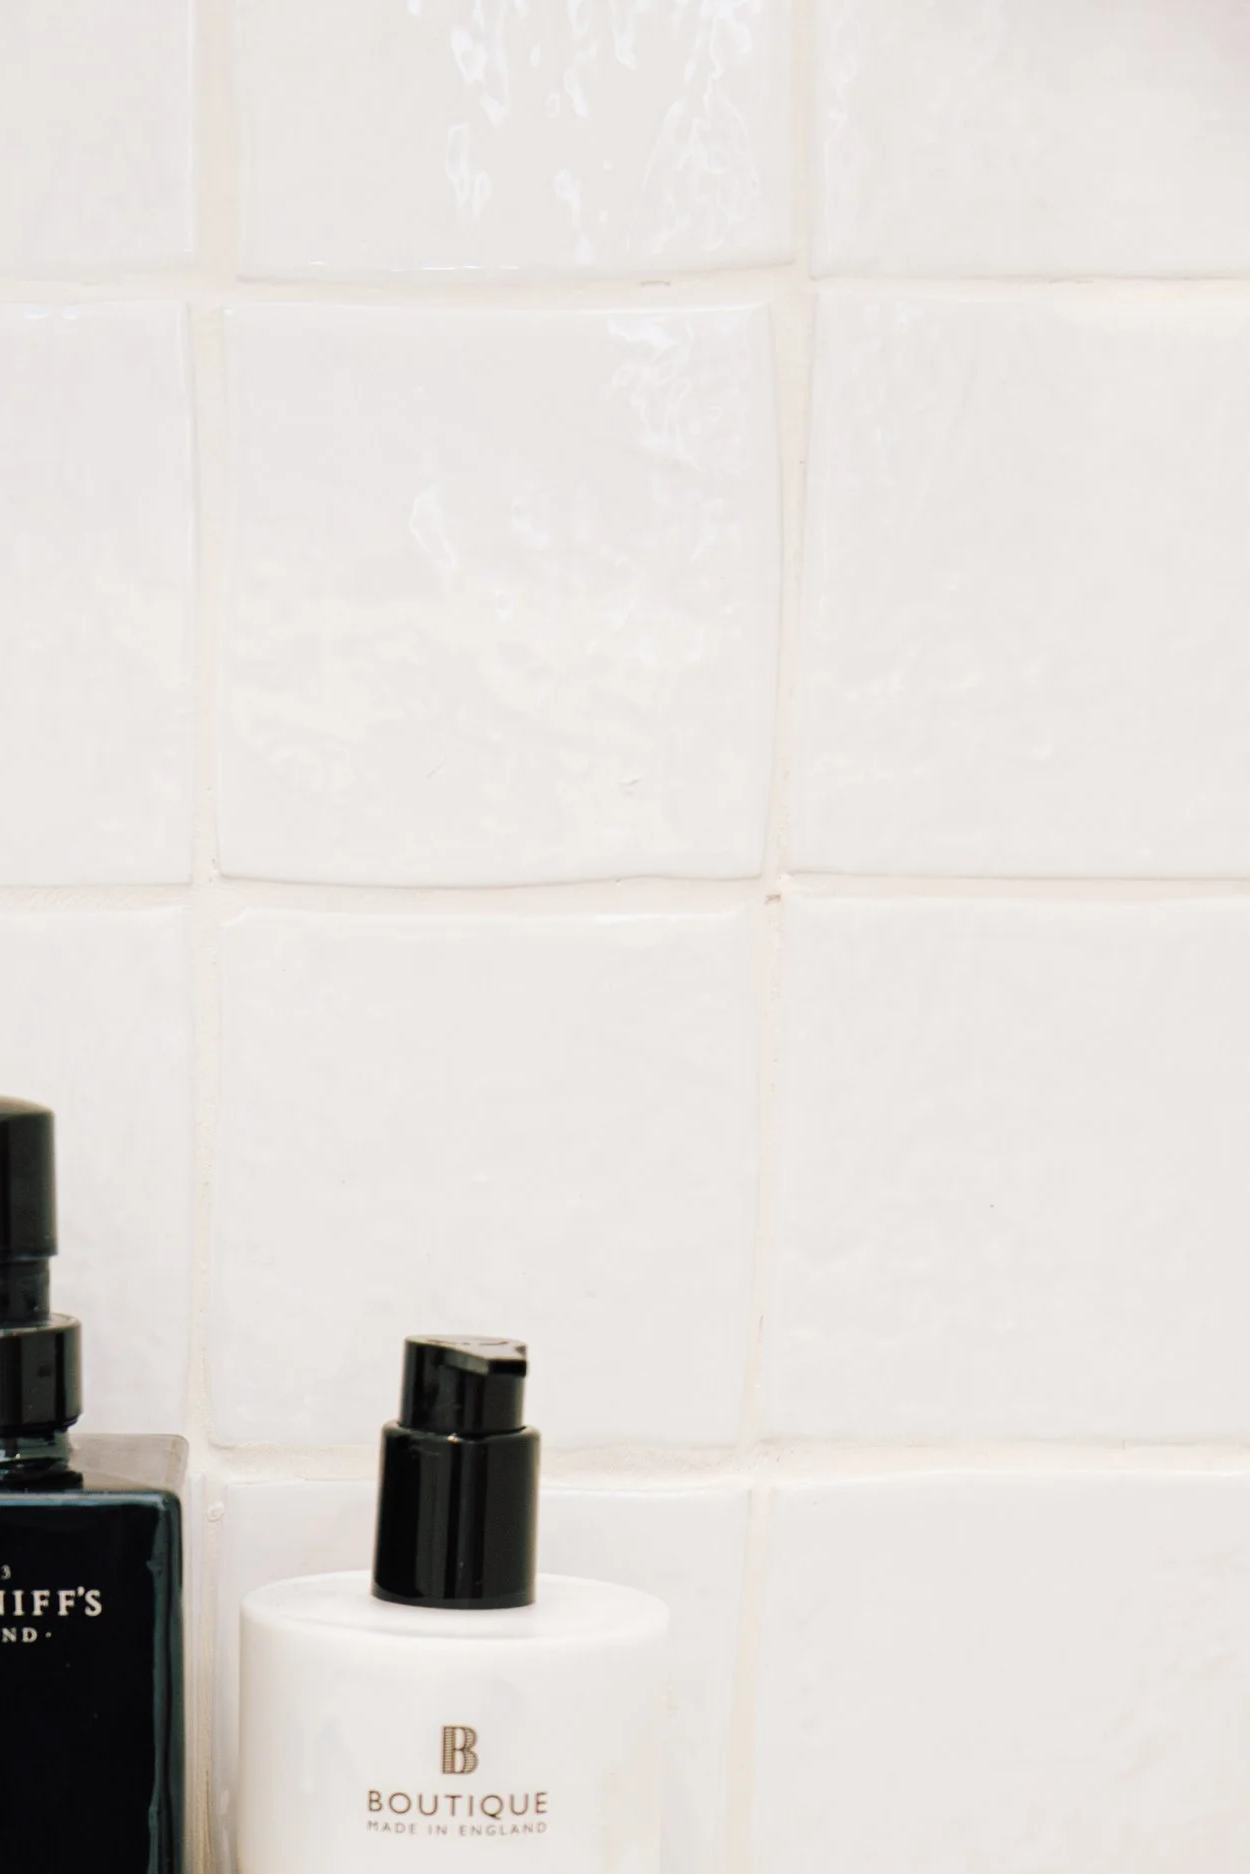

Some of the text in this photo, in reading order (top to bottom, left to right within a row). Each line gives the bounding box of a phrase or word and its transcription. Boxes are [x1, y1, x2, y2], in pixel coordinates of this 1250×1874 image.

[441, 1725, 479, 1775] B
[368, 1790, 549, 1819] BOUTIQUE
[367, 1820, 548, 1836] MADE IN ENGLAND
